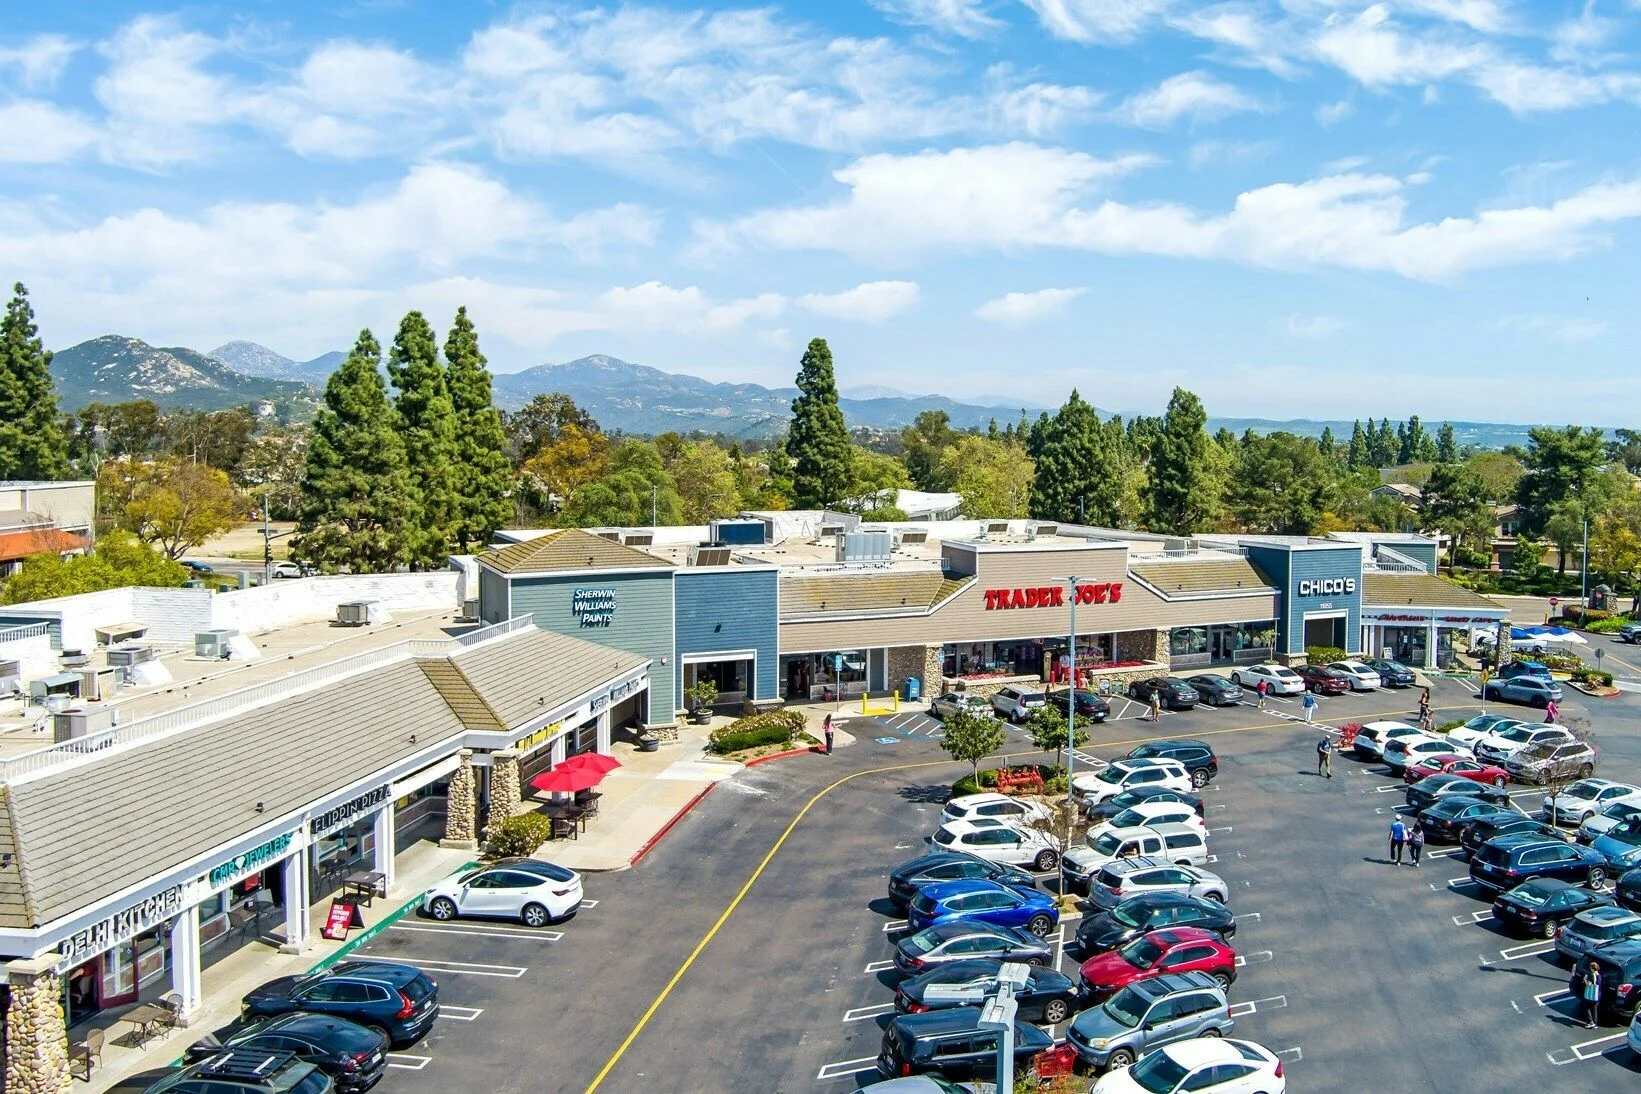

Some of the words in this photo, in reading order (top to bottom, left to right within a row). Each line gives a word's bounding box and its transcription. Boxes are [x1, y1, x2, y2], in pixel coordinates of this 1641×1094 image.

[574, 588, 616, 599] SHERWIN
[983, 587, 1064, 610] TRADER
[1074, 583, 1123, 605] JOE'S
[1299, 576, 1356, 596] CHICO'S
[573, 600, 617, 611] WILLIAMS
[582, 613, 613, 623] PAINTS
[361, 785, 392, 810] PIZZA
[212, 861, 237, 882] CMR
[244, 834, 292, 869] JEWELERS
[115, 885, 184, 937] KITCHEN
